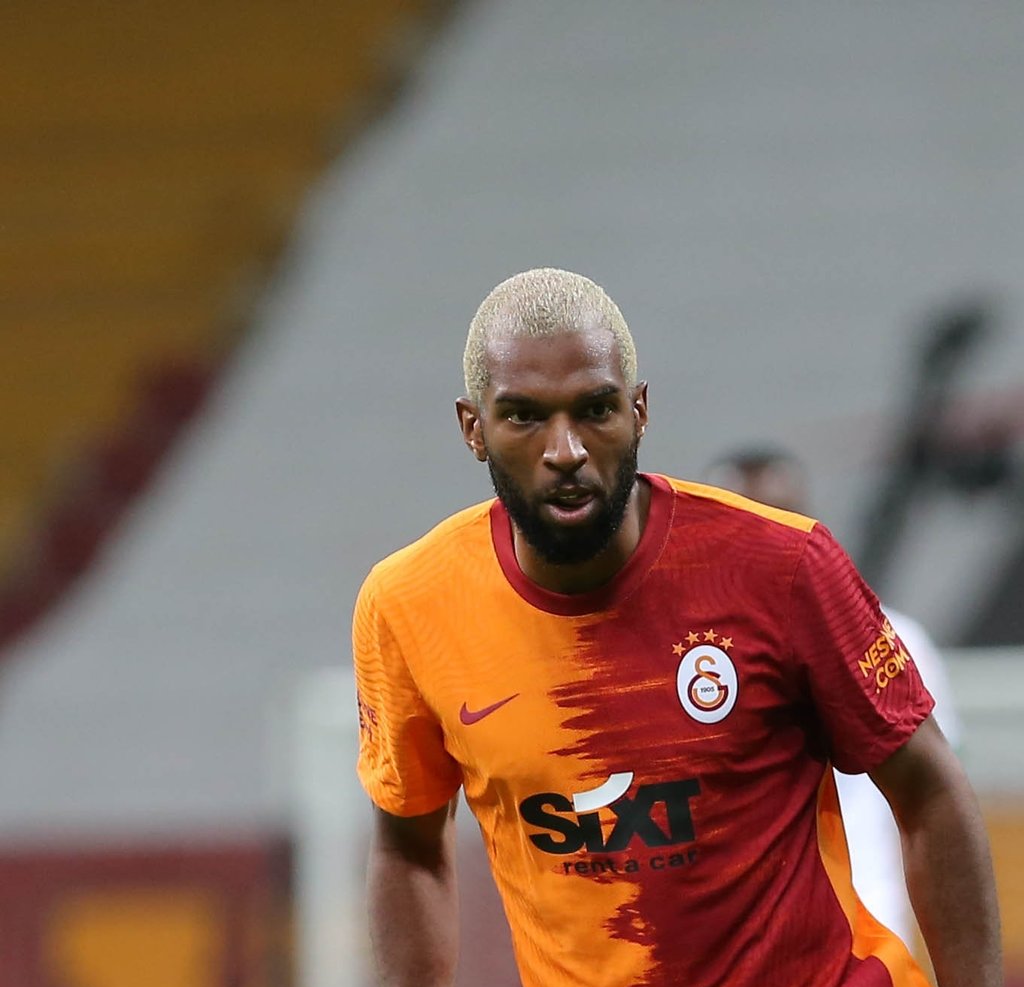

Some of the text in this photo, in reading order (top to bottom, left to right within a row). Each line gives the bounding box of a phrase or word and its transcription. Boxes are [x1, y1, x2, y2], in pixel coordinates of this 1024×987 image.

[562, 849, 697, 876] rent a car
